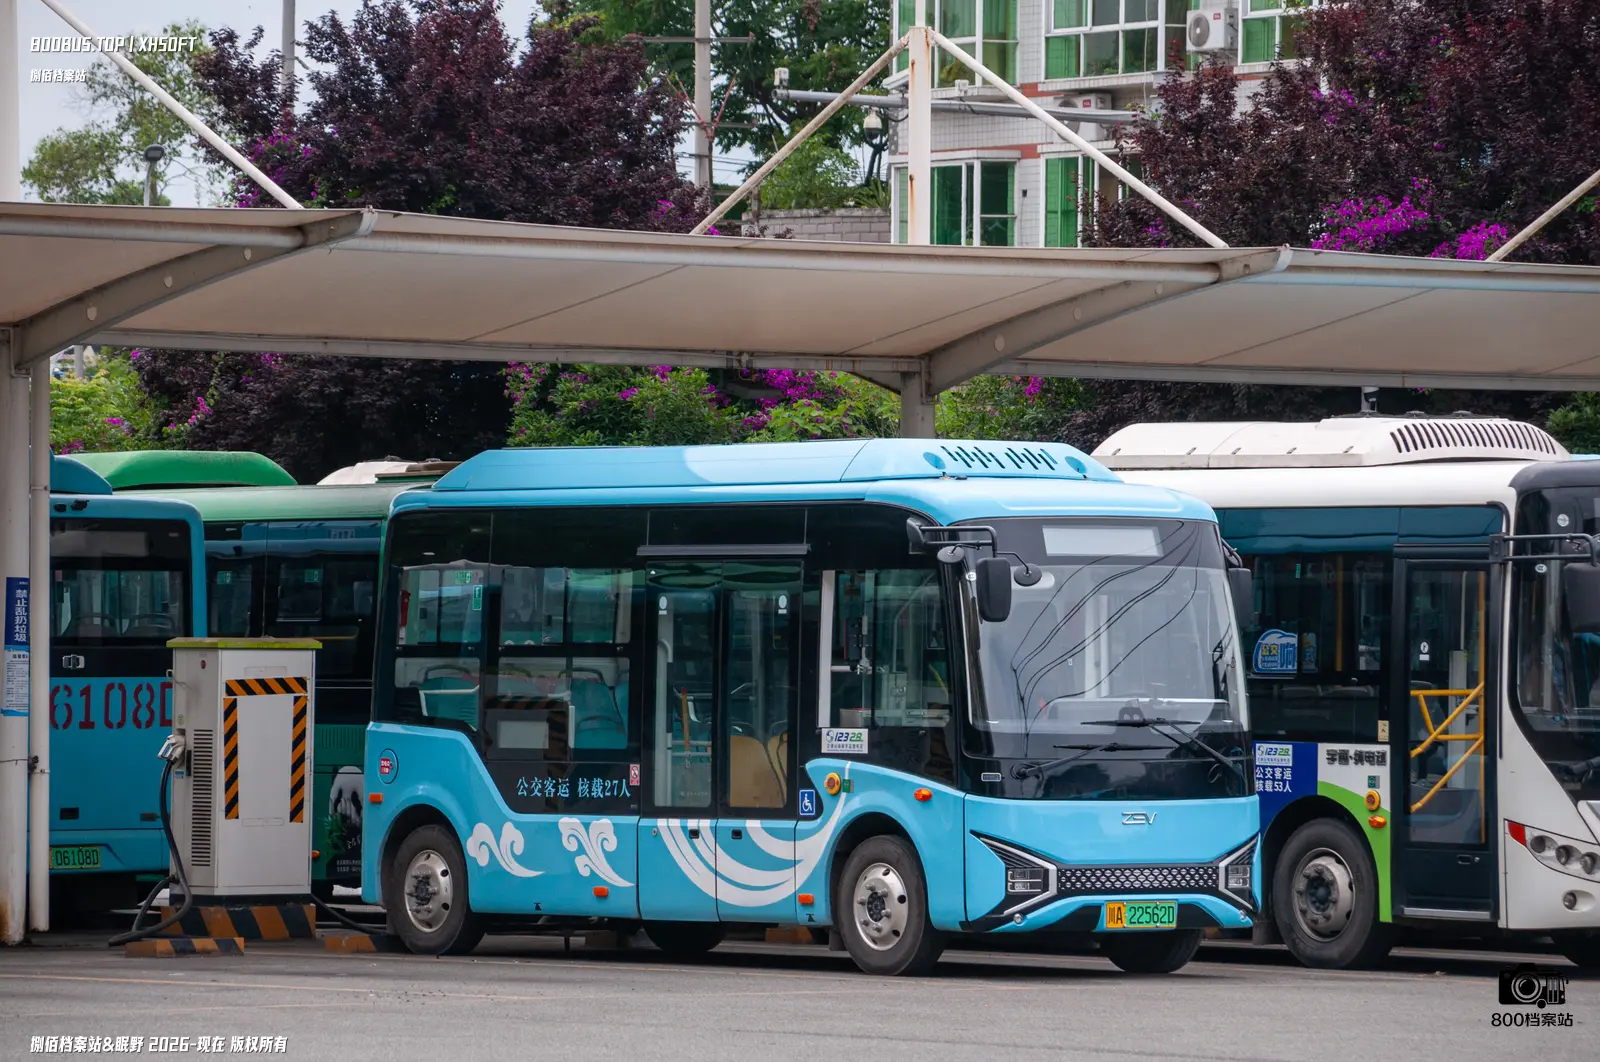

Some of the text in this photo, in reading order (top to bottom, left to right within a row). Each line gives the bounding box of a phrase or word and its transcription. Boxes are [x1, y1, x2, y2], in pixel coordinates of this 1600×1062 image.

[14, 589, 28, 642] 禁止乱扔垃圾
[834, 732, 864, 742] 12328
[1256, 766, 1292, 780] 公交客运
[516, 776, 631, 798] 公交客运 核载27人
[1256, 780, 1292, 792] 核载53人
[1121, 811, 1157, 825] ZEV
[55, 850, 99, 866] 06108D
[1129, 906, 1175, 924] 22562D
